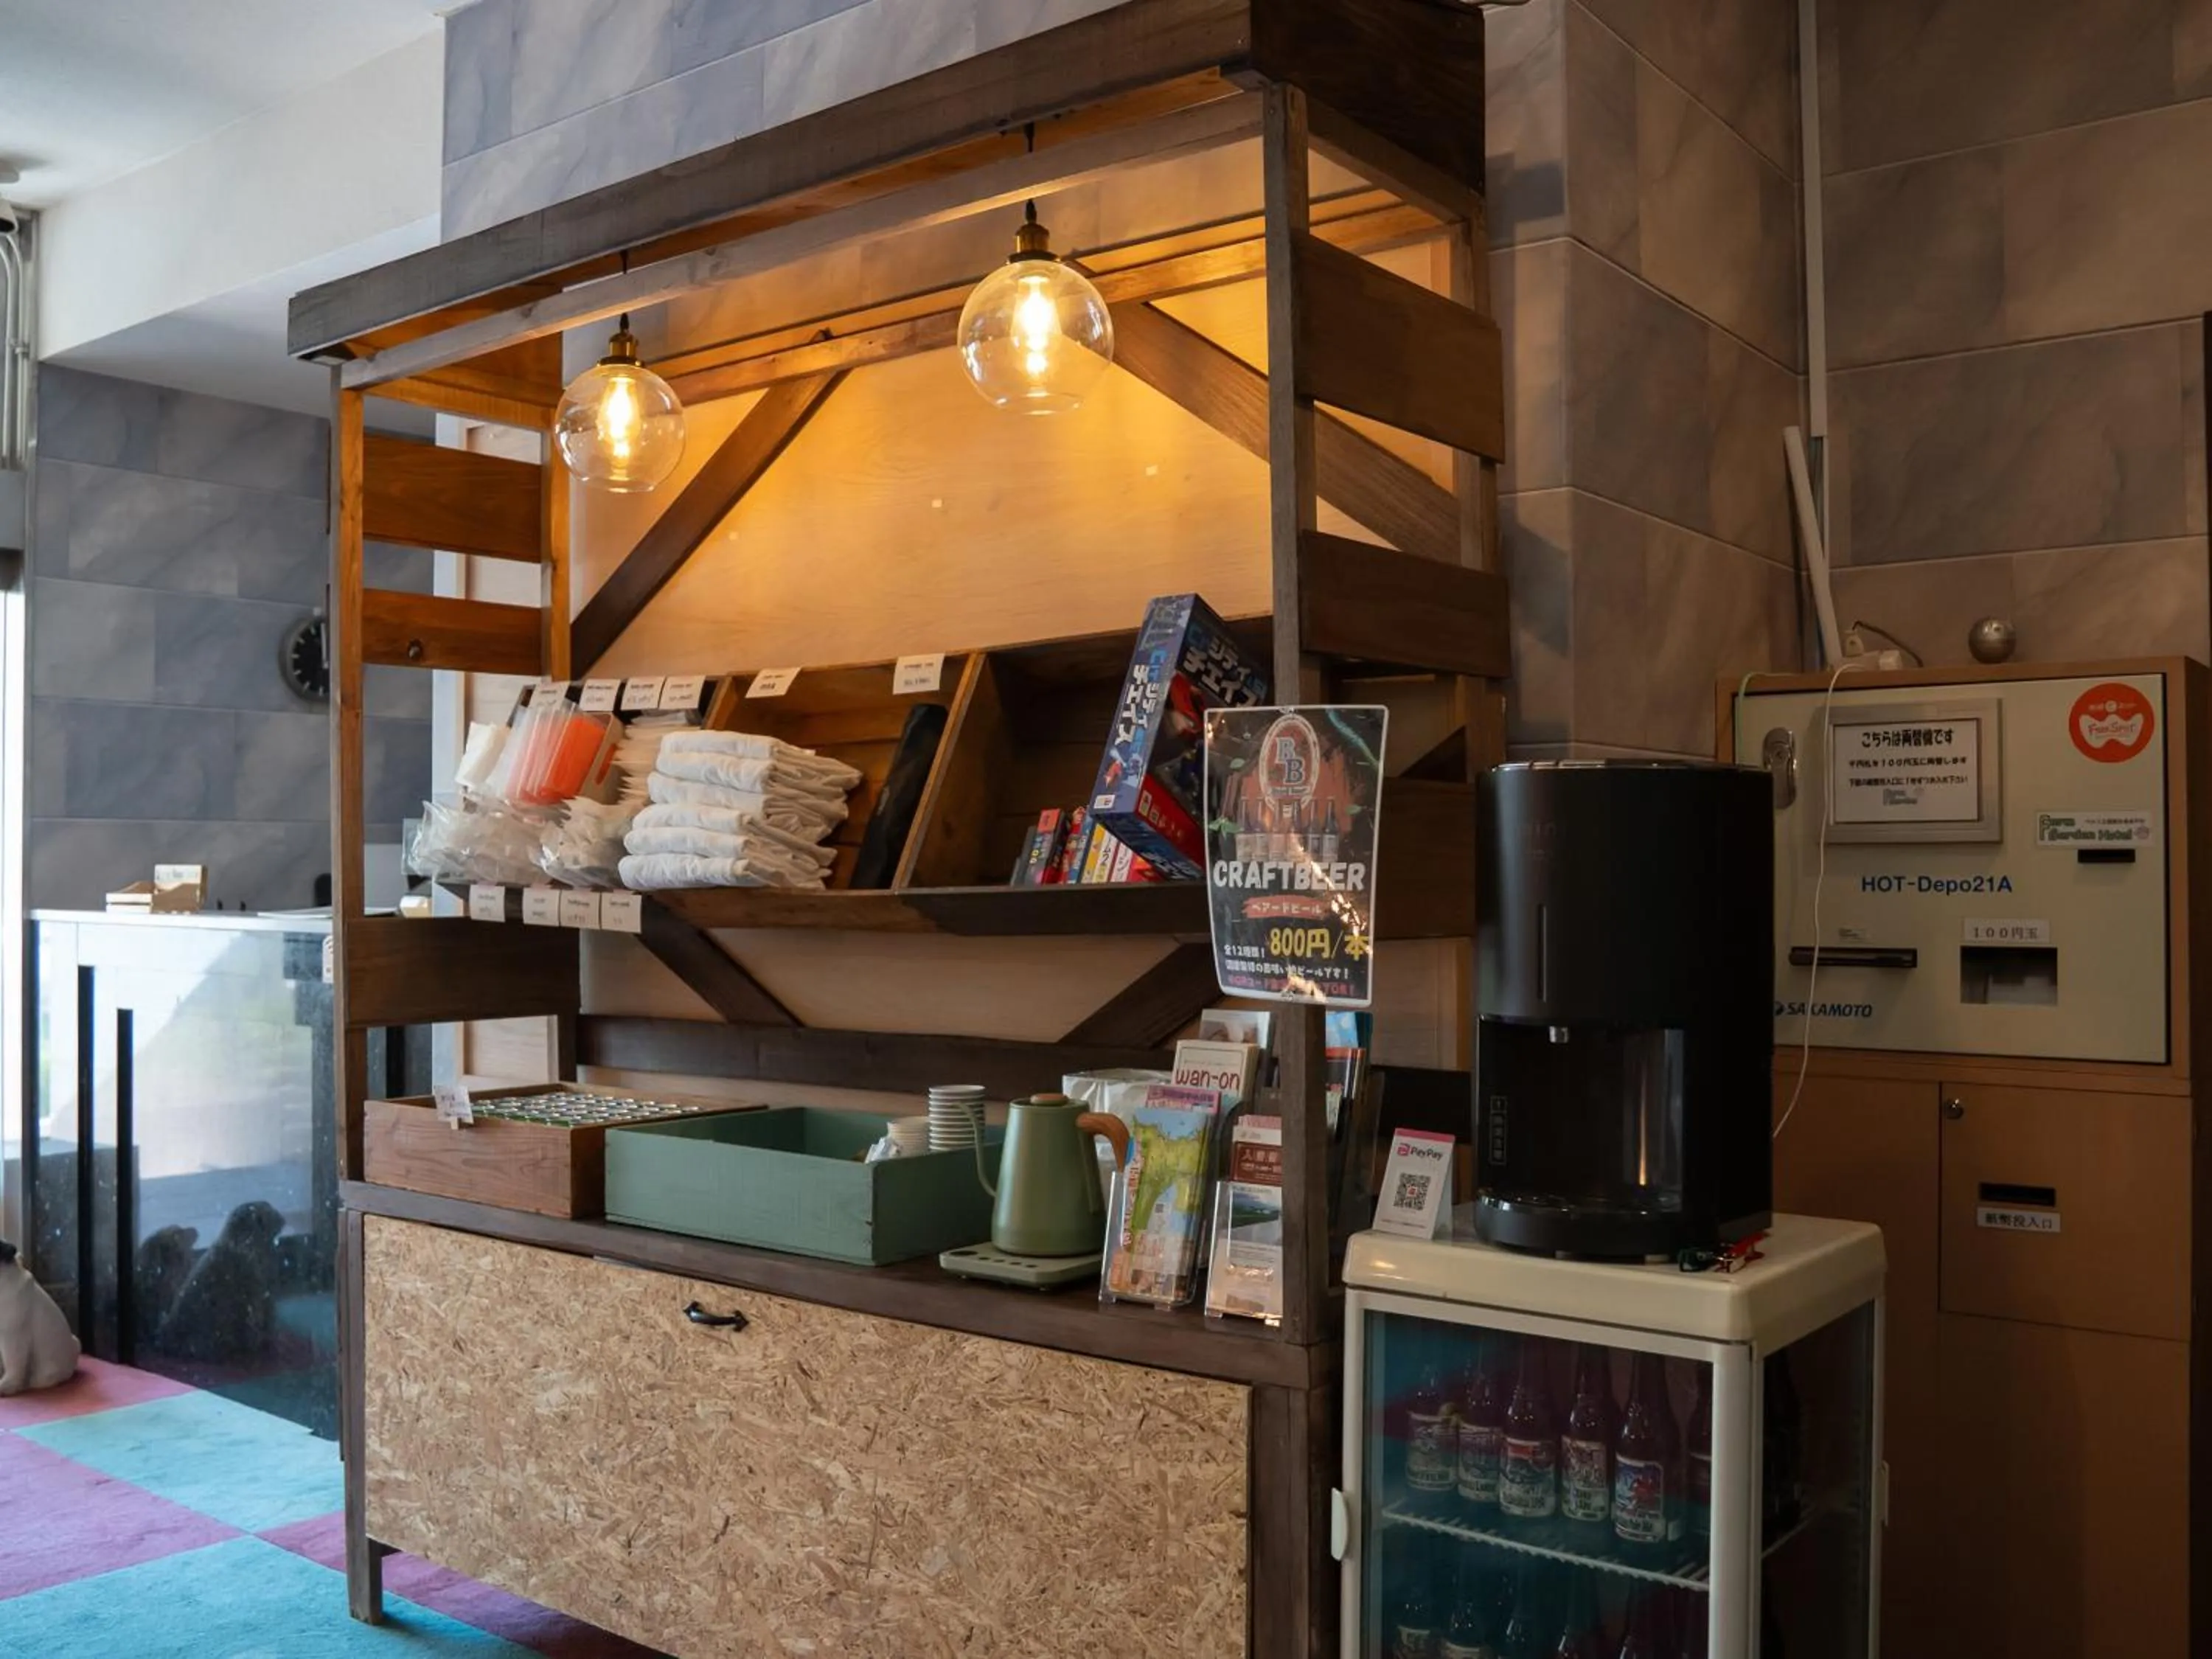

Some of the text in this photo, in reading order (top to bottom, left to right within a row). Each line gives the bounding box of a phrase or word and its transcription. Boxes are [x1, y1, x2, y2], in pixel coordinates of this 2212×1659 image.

[1861, 874, 2013, 896] HOT-Depo21A
[1972, 926, 2039, 940] 100円玉
[1175, 1069, 1240, 1091] wan-on
[1411, 1147, 1444, 1161] PayPay
